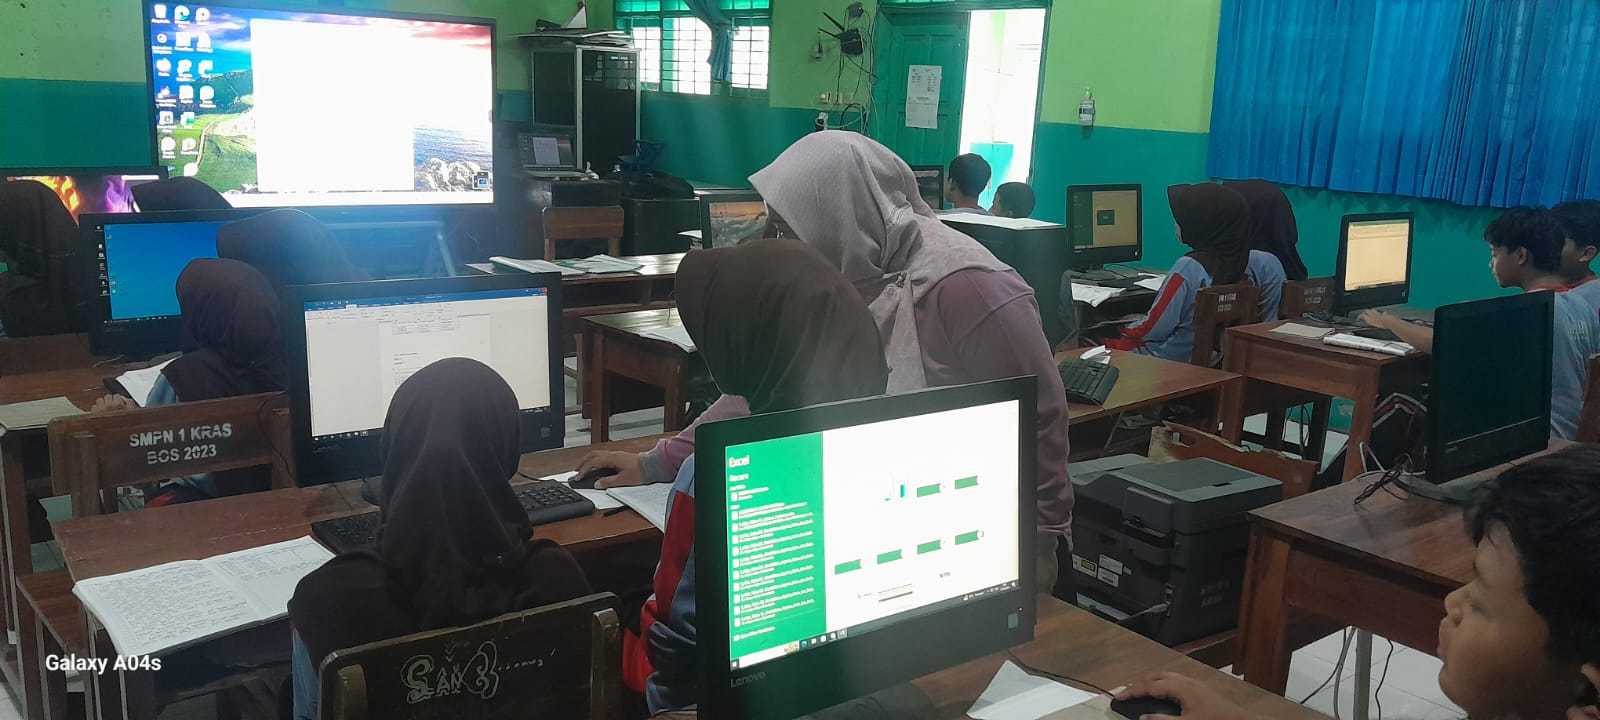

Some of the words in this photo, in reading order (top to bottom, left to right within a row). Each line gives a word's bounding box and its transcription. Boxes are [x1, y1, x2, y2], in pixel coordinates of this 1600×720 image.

[129, 430, 174, 447] SMPN
[178, 428, 185, 441] 1
[190, 423, 232, 441] KRAS
[184, 444, 217, 460] 2023
[730, 671, 767, 688] Lenovo
